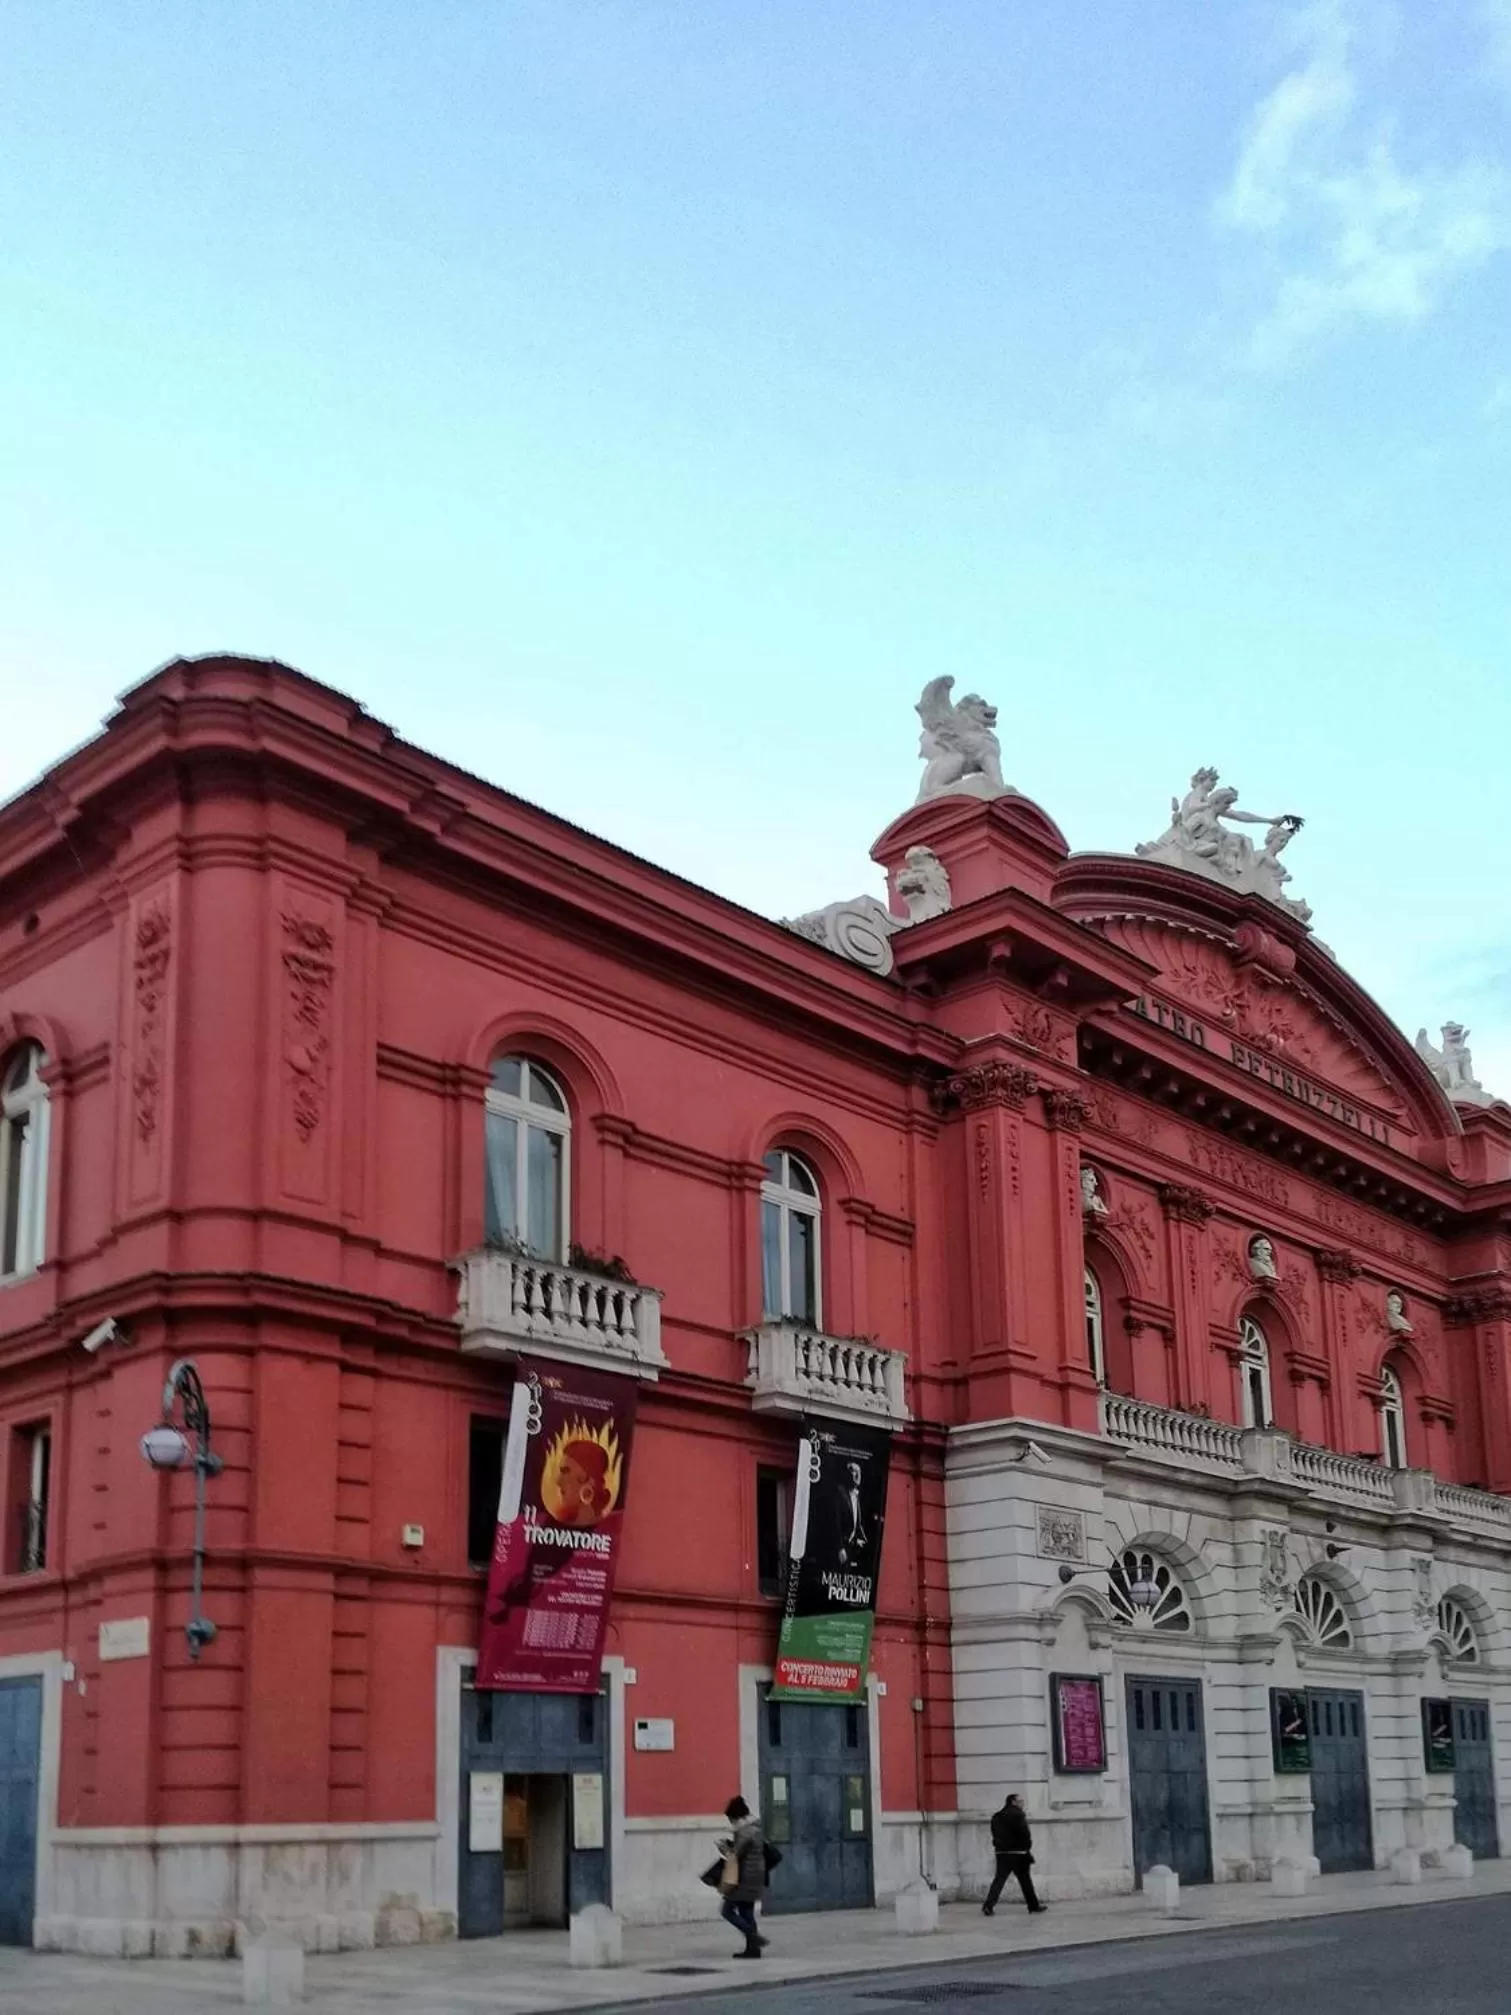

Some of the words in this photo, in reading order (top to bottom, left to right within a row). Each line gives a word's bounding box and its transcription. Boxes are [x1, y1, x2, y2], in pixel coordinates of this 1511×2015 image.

[1135, 991, 1205, 1047] ATRO
[523, 1523, 612, 1553] TROVATORE
[821, 1570, 872, 1590] MAURIZIO
[828, 1586, 870, 1604] POLLINI
[781, 1661, 824, 1676] CONCERTO
[787, 1672, 800, 1685] AL
